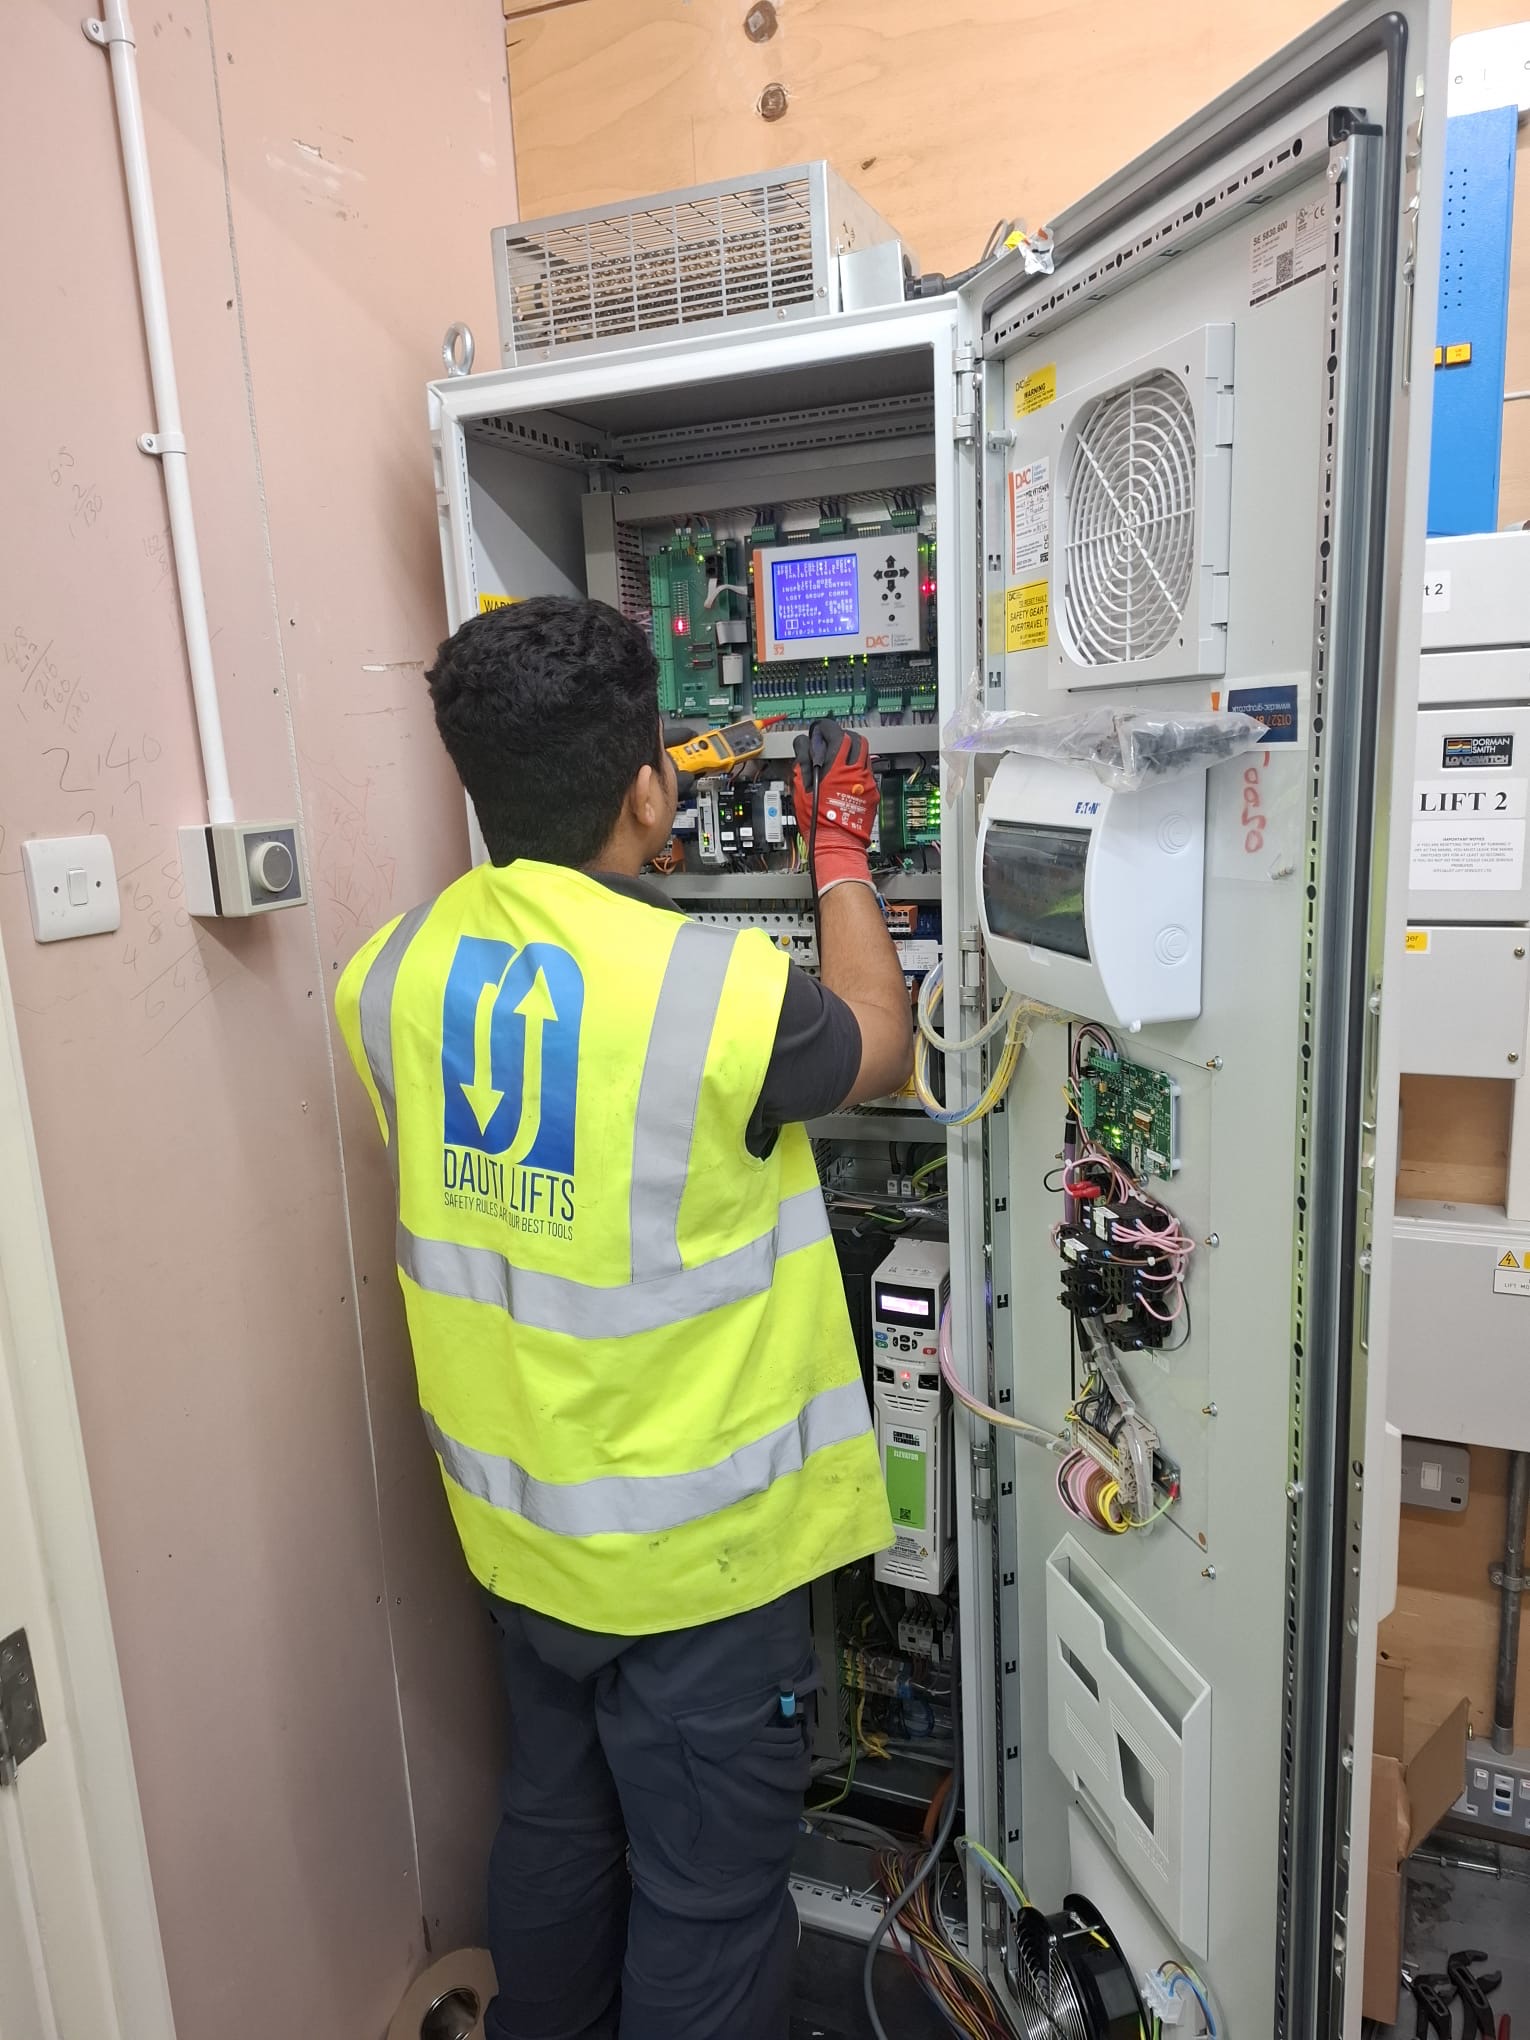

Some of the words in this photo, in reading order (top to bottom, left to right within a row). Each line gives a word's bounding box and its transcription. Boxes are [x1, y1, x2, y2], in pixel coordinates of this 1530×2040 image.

[1015, 468, 1031, 490] DAC
[783, 583, 820, 593] INSPECTION
[825, 581, 852, 589] CONTROL
[1434, 583, 1443, 595] 2
[1010, 609, 1029, 621] SAFETY
[1030, 606, 1044, 617] GEAR
[1011, 618, 1043, 633] OVERTRAVEL
[866, 635, 890, 648] DAC
[1472, 738, 1510, 746] DORMAN
[1472, 746, 1496, 754] SMITH
[1419, 792, 1487, 812] LIFT
[1494, 791, 1507, 811] 2
[444, 1148, 504, 1203] DAUTI
[510, 1167, 575, 1222] LIFTS
[444, 1192, 475, 1210] SAFETY
[475, 1198, 498, 1218] RULES
[521, 1217, 544, 1235] BEST
[547, 1221, 573, 1241] TOOLS
